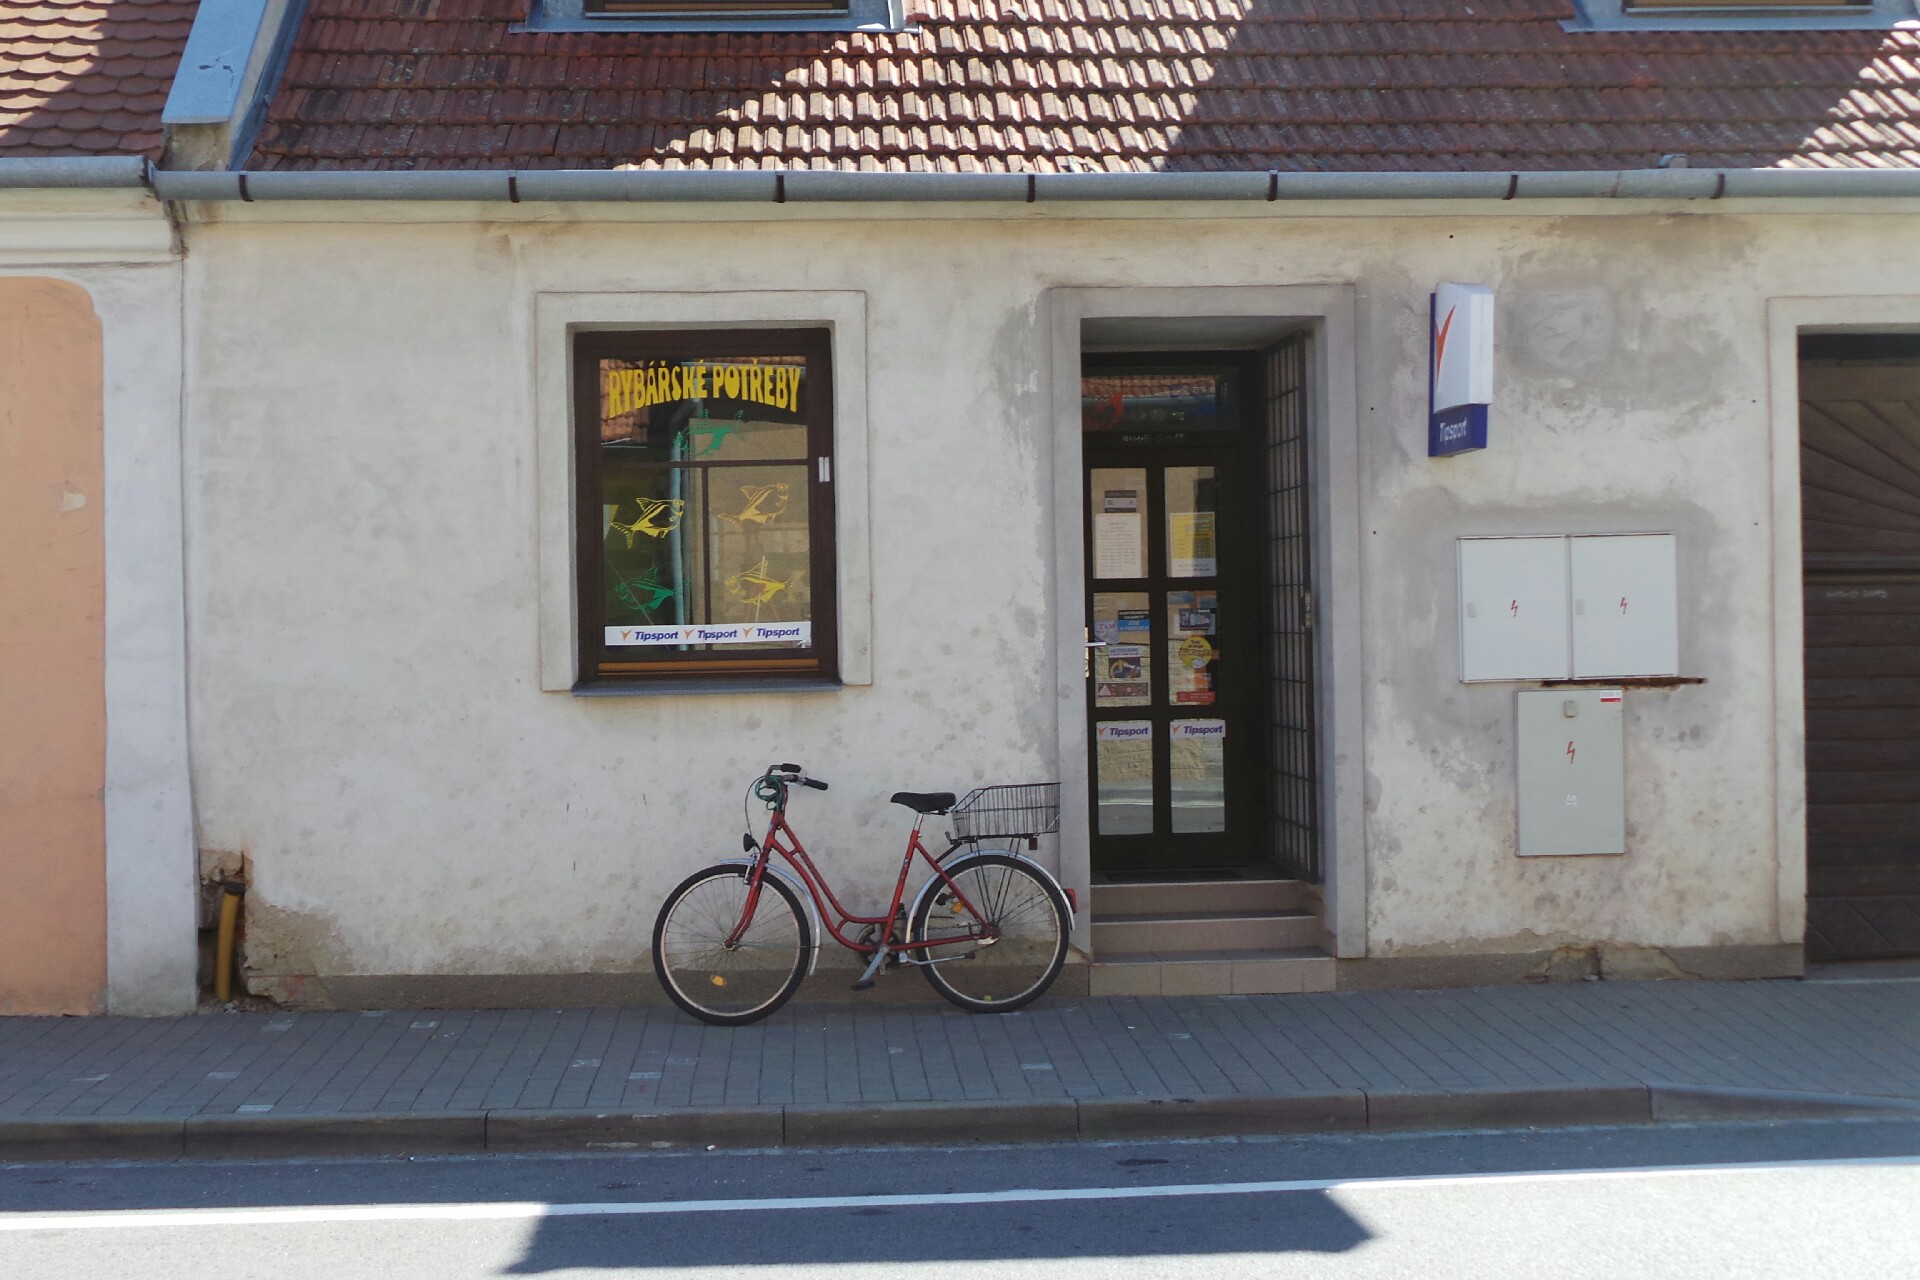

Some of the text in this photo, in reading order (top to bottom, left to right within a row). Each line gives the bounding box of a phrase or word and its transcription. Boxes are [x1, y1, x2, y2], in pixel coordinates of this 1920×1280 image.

[608, 357, 801, 419] RYBÁŘSKÉ POTŘEBY
[1440, 417, 1467, 445] Tipsport
[635, 627, 800, 642] Tipsport Tipsport Tipsport
[1109, 727, 1149, 737] Tipsport
[1183, 725, 1223, 735] Tipsport
